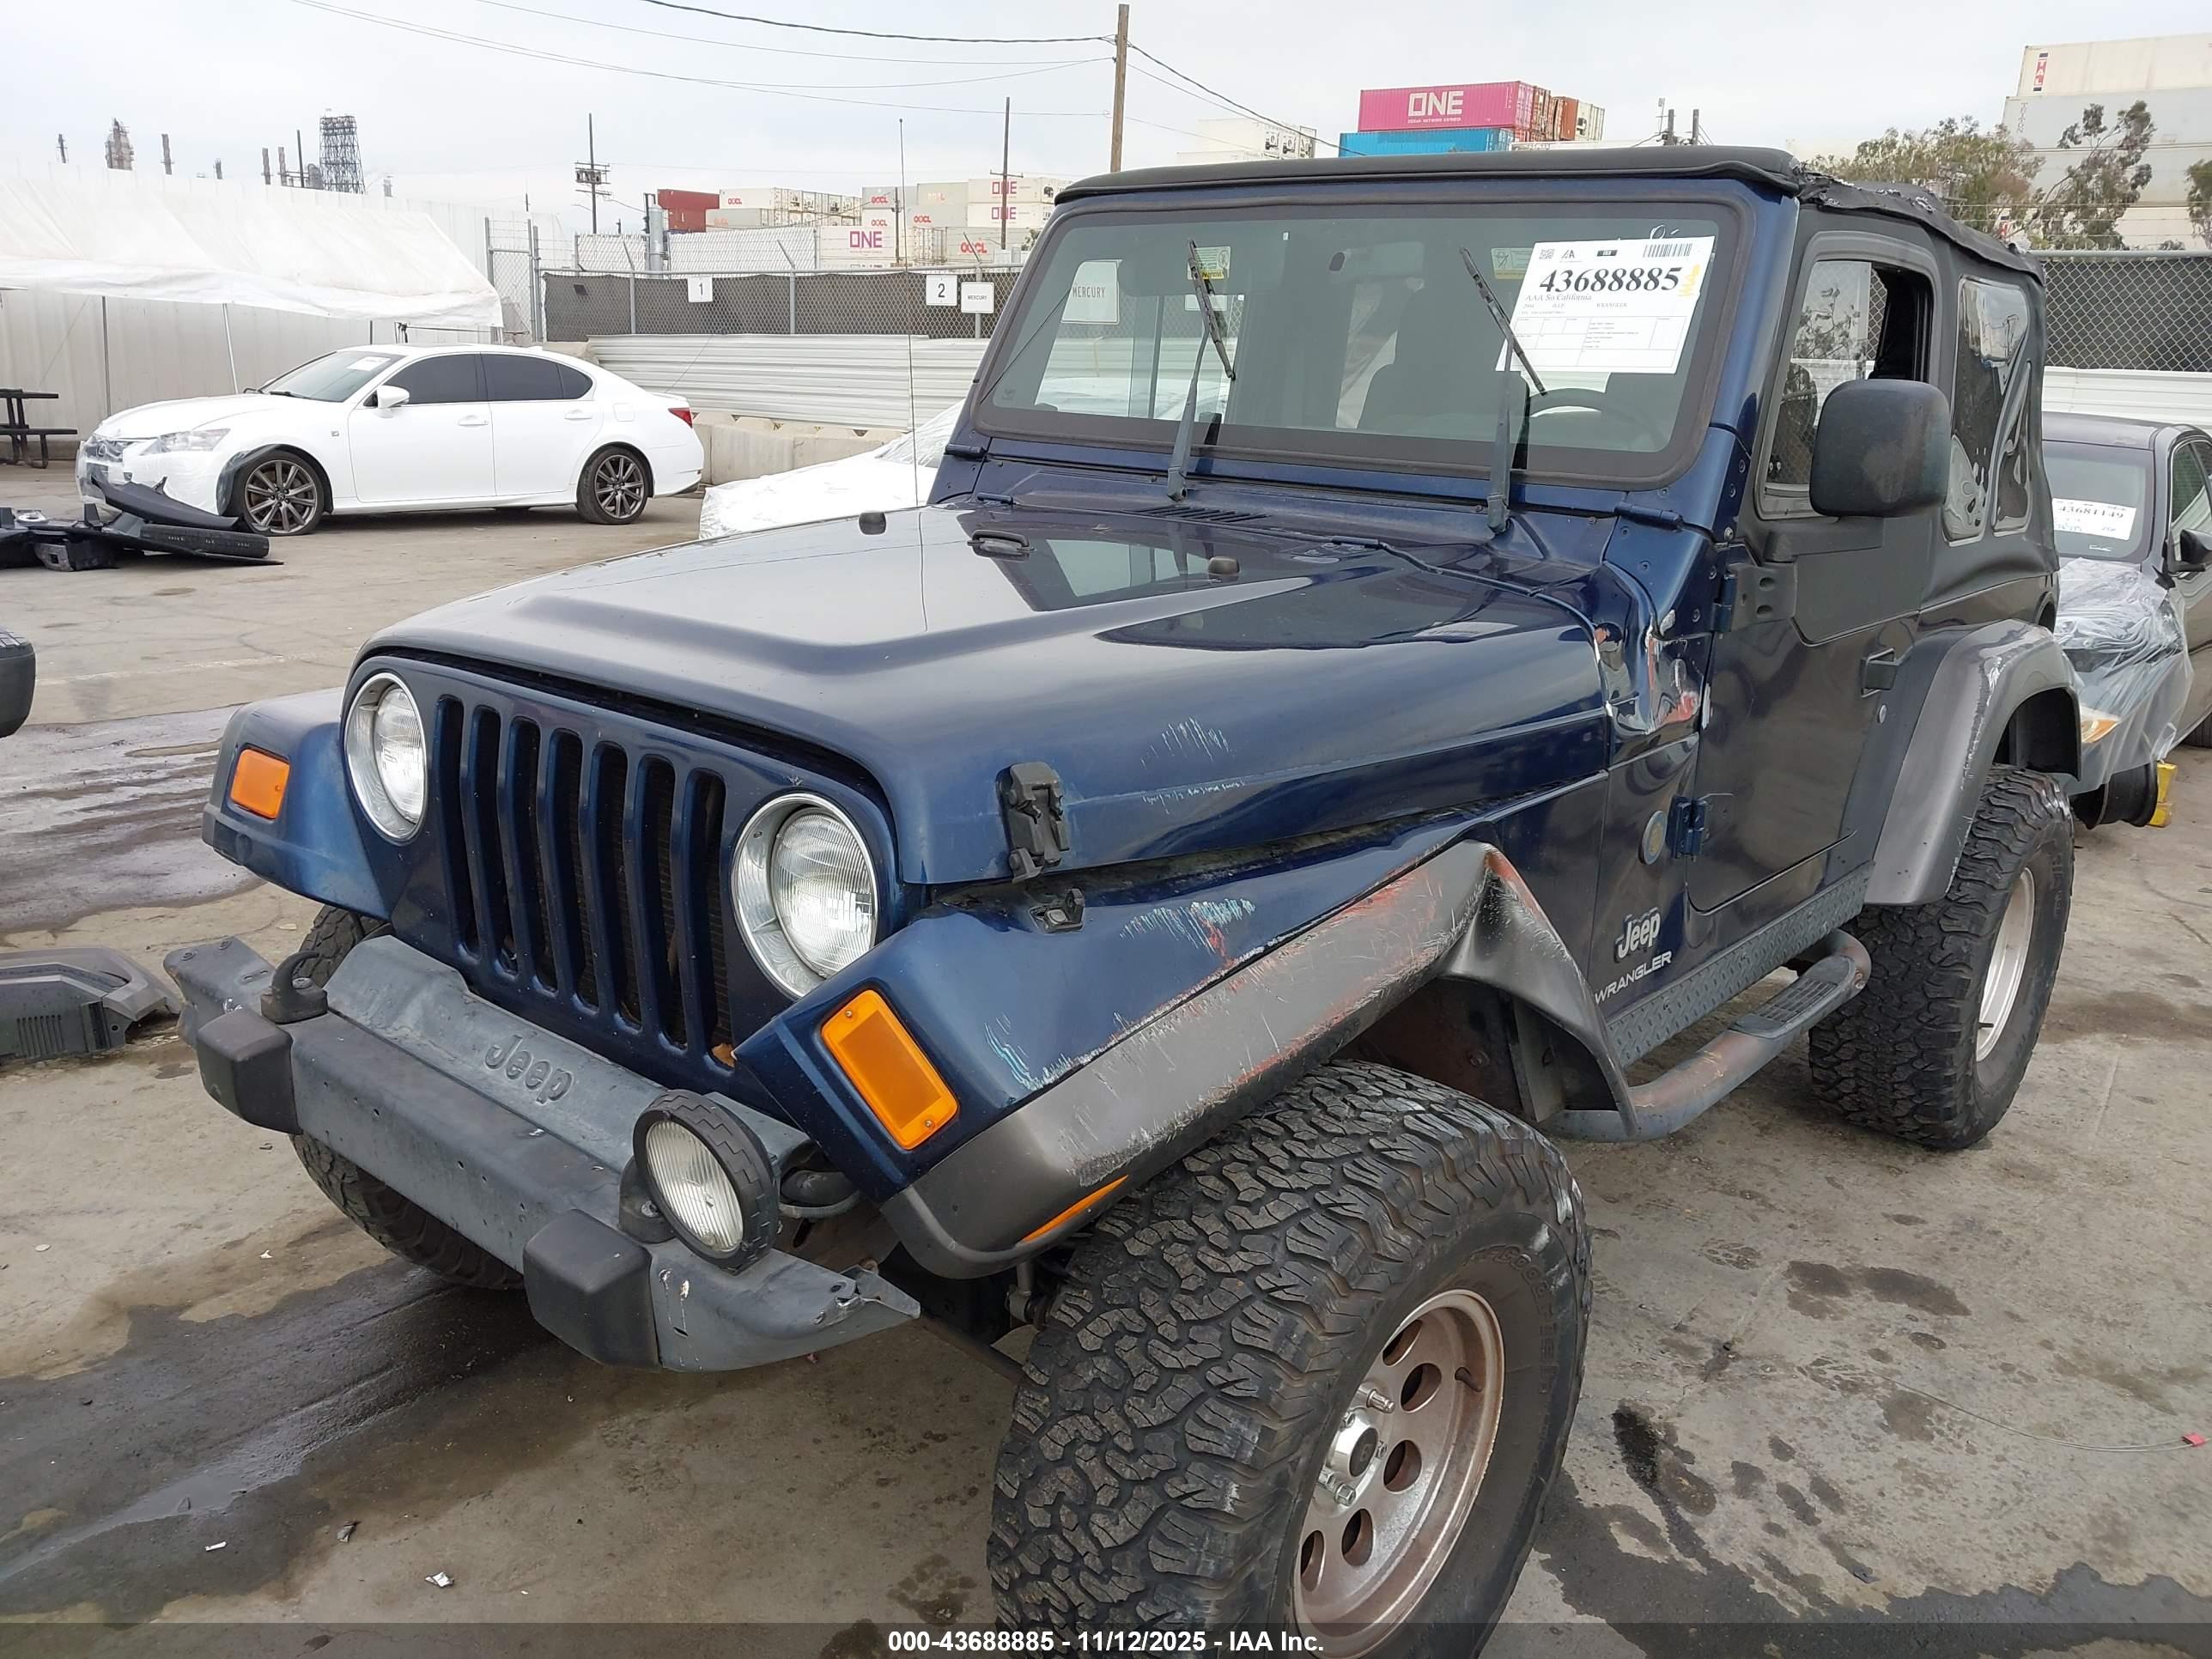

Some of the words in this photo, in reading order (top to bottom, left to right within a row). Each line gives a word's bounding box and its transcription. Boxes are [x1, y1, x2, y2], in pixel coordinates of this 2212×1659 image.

[1408, 91, 1463, 116] ONE
[849, 231, 883, 248] ONE
[960, 241, 988, 253] OOCL
[1540, 266, 1683, 293] 43688885
[699, 283, 703, 295] 1
[938, 283, 945, 298] 2
[1073, 286, 1106, 299] MERCURY
[1556, 293, 1592, 302] California
[1619, 913, 1661, 958] Jeep
[1595, 951, 1672, 1004] WRANGLER
[485, 1035, 574, 1105] Jeep
